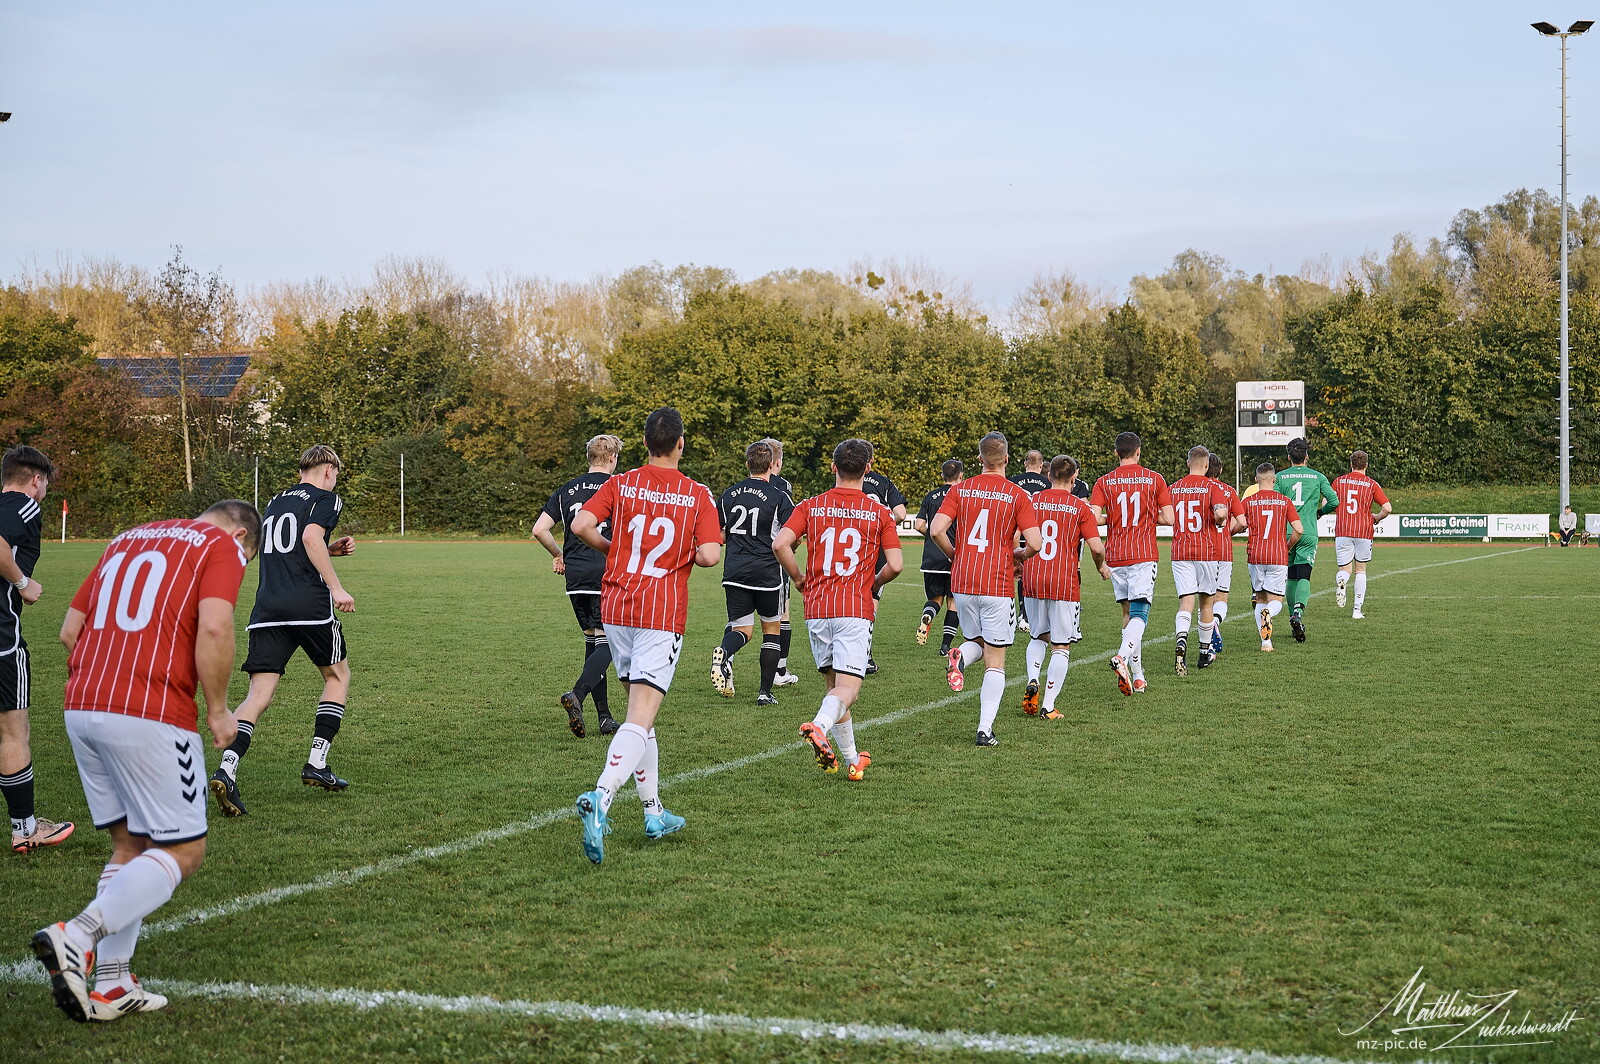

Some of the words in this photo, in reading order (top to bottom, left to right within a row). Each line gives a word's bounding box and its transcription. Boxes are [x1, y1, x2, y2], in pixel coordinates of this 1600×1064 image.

[1241, 401, 1262, 409] HEIM
[1279, 400, 1300, 409] GAST
[568, 483, 579, 496] SV
[1027, 478, 1047, 488] Laufen
[1106, 477, 1117, 486] TUS
[1117, 476, 1153, 485] ENGELSBERG
[281, 489, 311, 501] Laufen
[620, 484, 637, 499] TUS
[638, 487, 695, 508] ENGELSBERG
[730, 487, 742, 498] SV
[743, 486, 768, 502] Laufen
[931, 490, 941, 500] SV
[959, 488, 971, 498] TUS
[971, 489, 1014, 504] ENGELSBERG
[1292, 481, 1305, 506] 1
[1346, 489, 1358, 515] 5
[730, 504, 760, 537] 21
[811, 507, 826, 517] TUS
[827, 507, 877, 522] ENGELSBERG
[1039, 502, 1078, 516] ENGELSBERG
[1116, 491, 1141, 528] 11
[1175, 500, 1202, 533] 15
[263, 512, 298, 554] 10
[967, 508, 990, 553] 4
[1261, 509, 1274, 540] 7
[1402, 516, 1447, 528] Gasthaus
[1449, 516, 1487, 528] Greimel
[127, 527, 207, 548] ENGELSBERG
[626, 513, 676, 579] 12
[1039, 519, 1059, 561] 8
[820, 526, 862, 577] 13
[93, 550, 168, 632] 10
